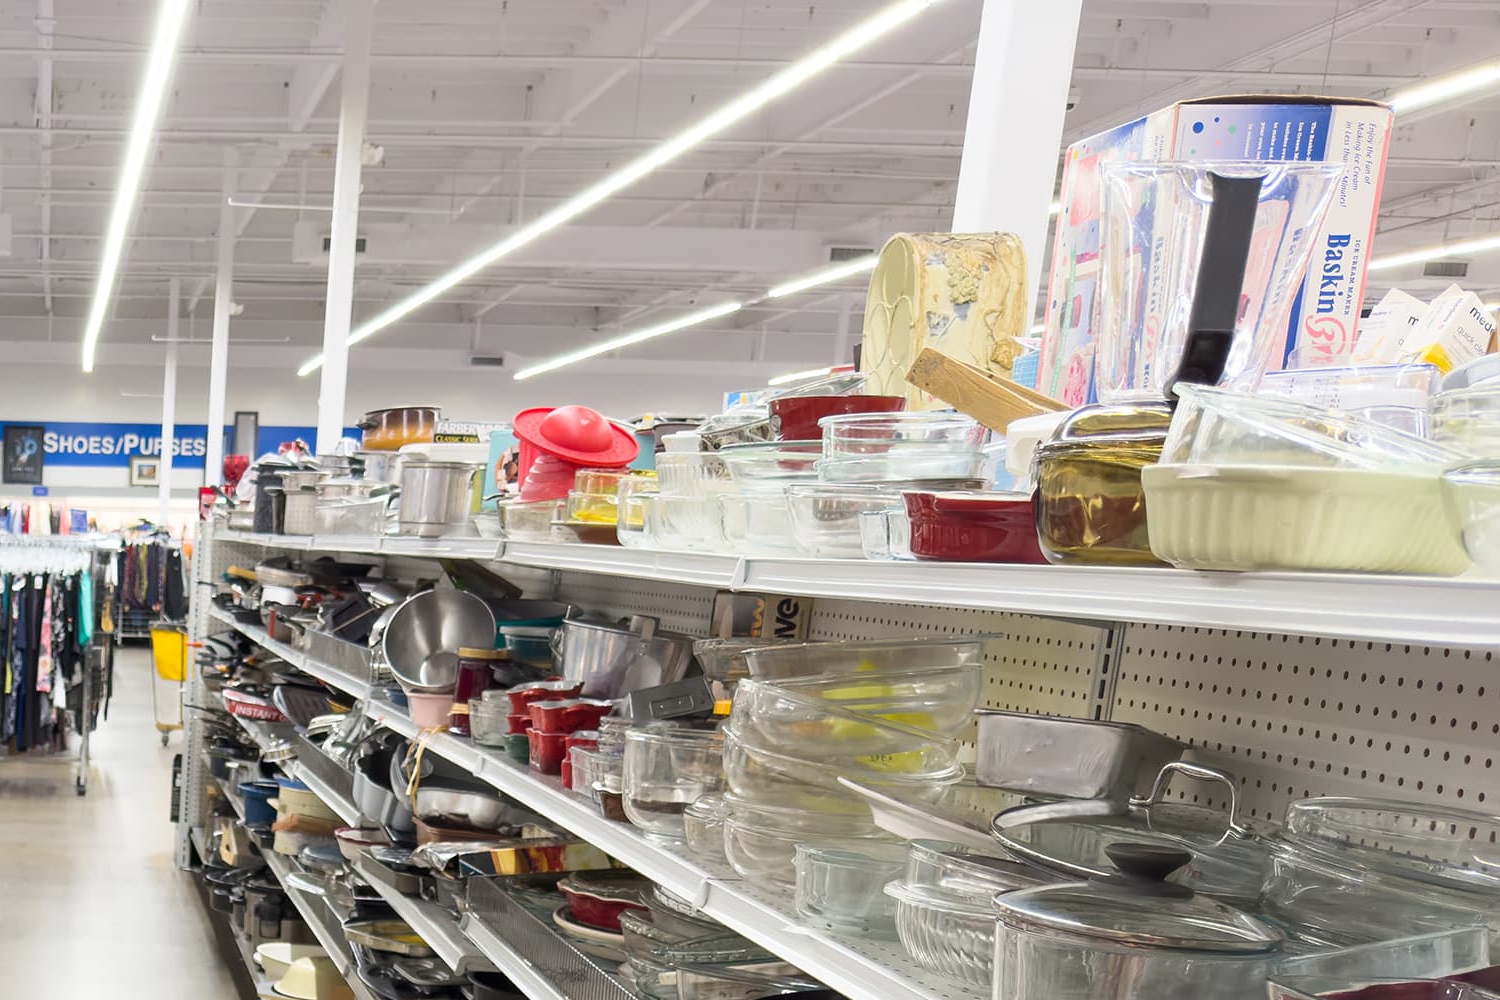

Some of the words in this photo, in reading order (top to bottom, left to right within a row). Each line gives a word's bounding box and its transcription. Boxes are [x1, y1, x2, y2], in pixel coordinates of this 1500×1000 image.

[1353, 122, 1365, 154] Making
[1352, 167, 1362, 191] Cream
[1316, 233, 1351, 314] Baskin
[1349, 255, 1359, 284] CREAM
[1344, 286, 1354, 315] MAKER
